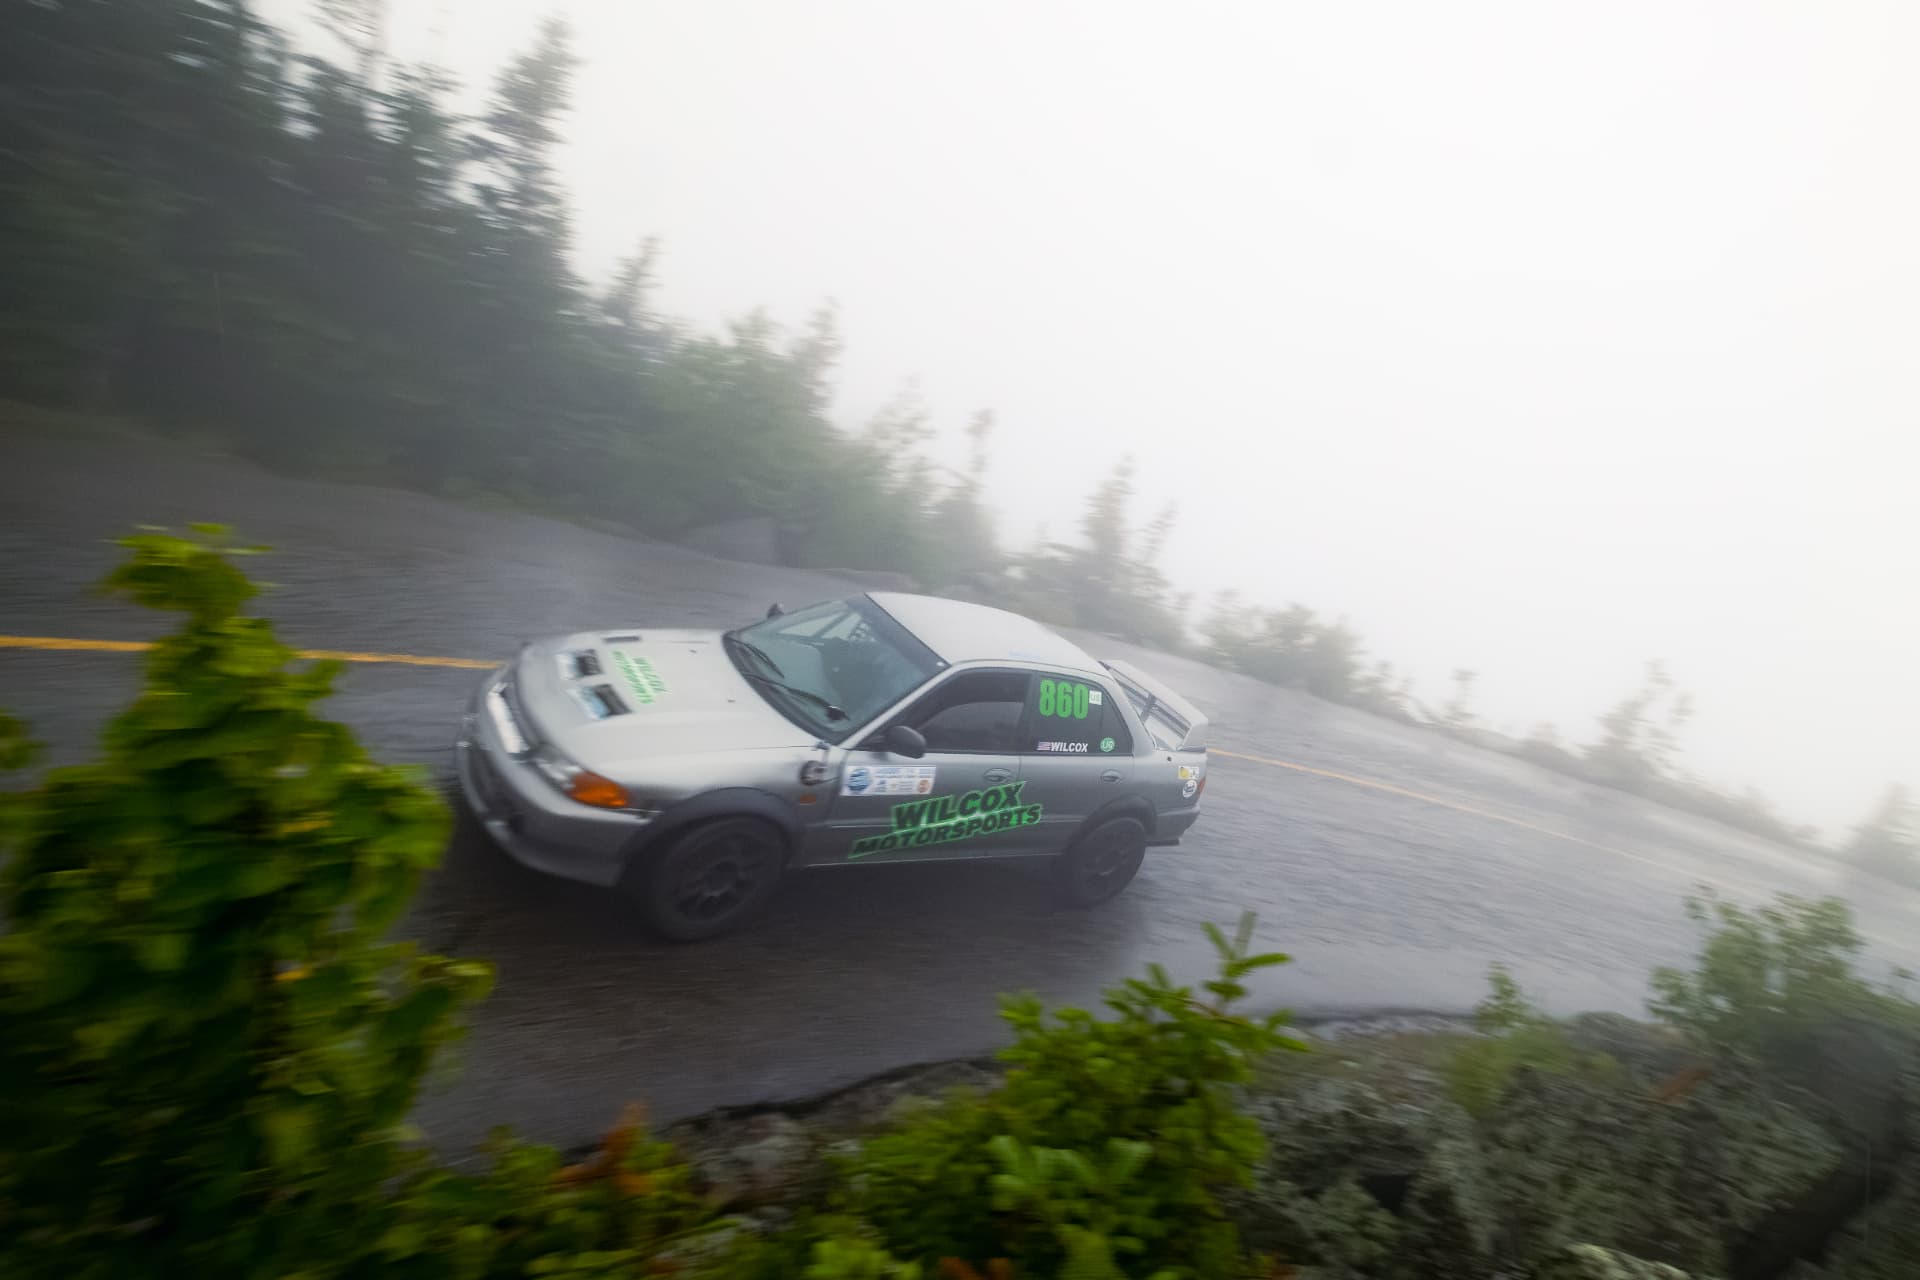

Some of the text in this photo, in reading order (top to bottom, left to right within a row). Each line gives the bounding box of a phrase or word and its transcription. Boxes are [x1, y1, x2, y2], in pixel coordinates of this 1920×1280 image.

[1040, 679, 1089, 720] 860
[1051, 741, 1088, 752] WILCOX
[853, 804, 1041, 852] MOTORSPORTS
[894, 782, 1024, 833] WILCOX
